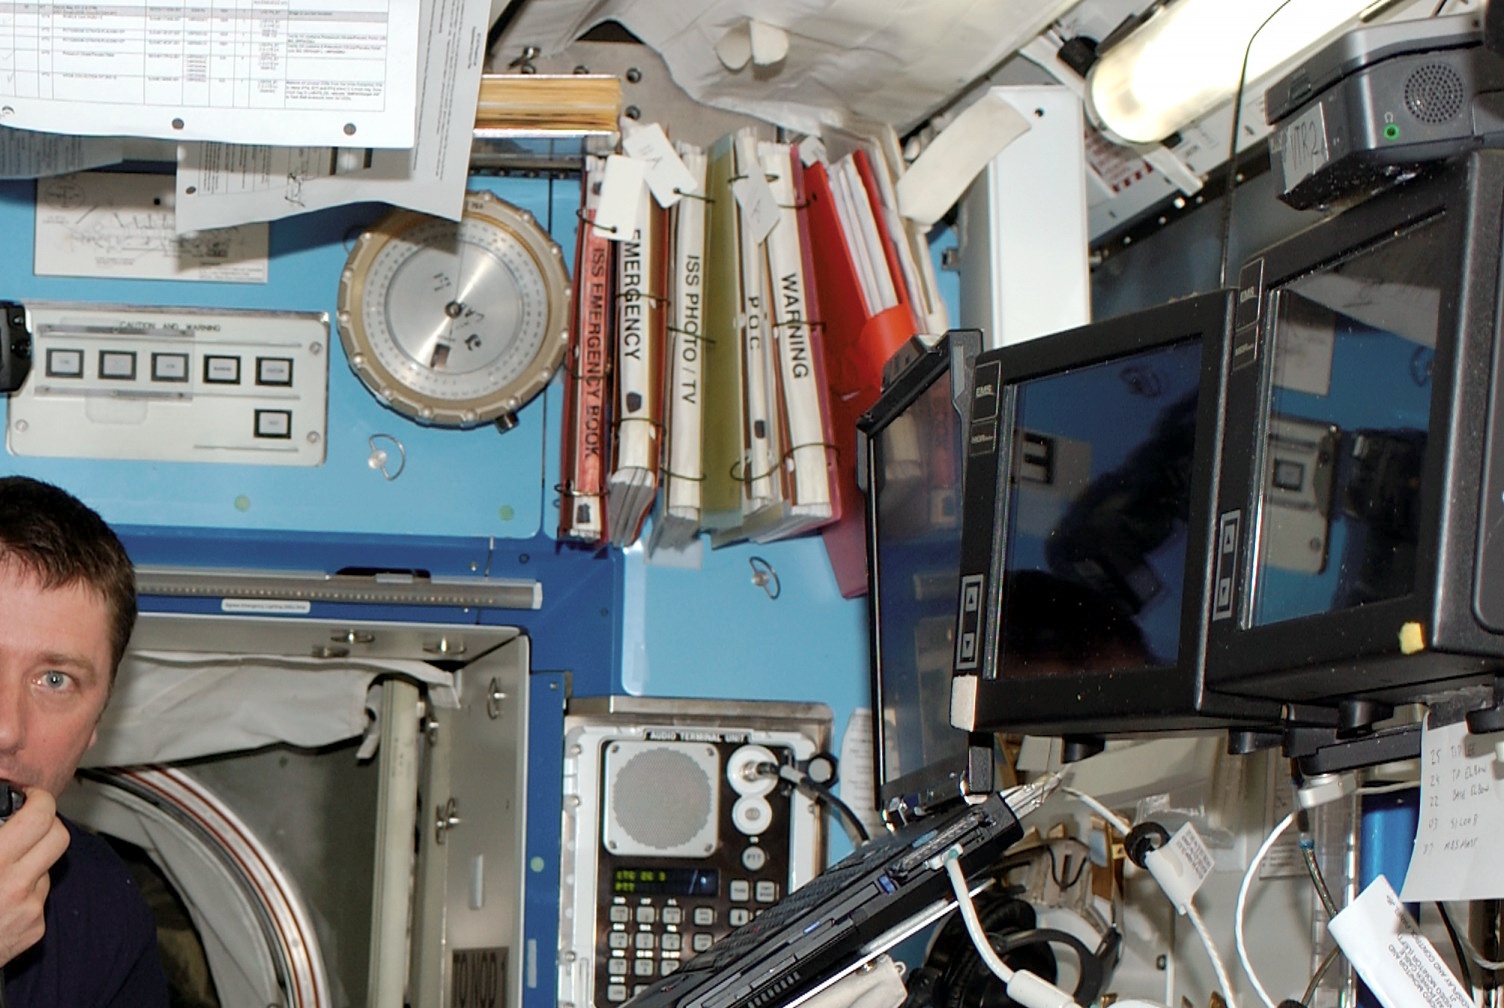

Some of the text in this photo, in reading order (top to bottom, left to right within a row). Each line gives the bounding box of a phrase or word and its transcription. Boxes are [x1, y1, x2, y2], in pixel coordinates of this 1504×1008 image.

[685, 255, 700, 286] ISS
[683, 293, 699, 362] PHOTO
[781, 273, 809, 379] WARNING
[585, 248, 605, 456] ISS EMERGENCY BOOK
[682, 379, 697, 404] TV
[679, 732, 722, 742] TERMINAL
